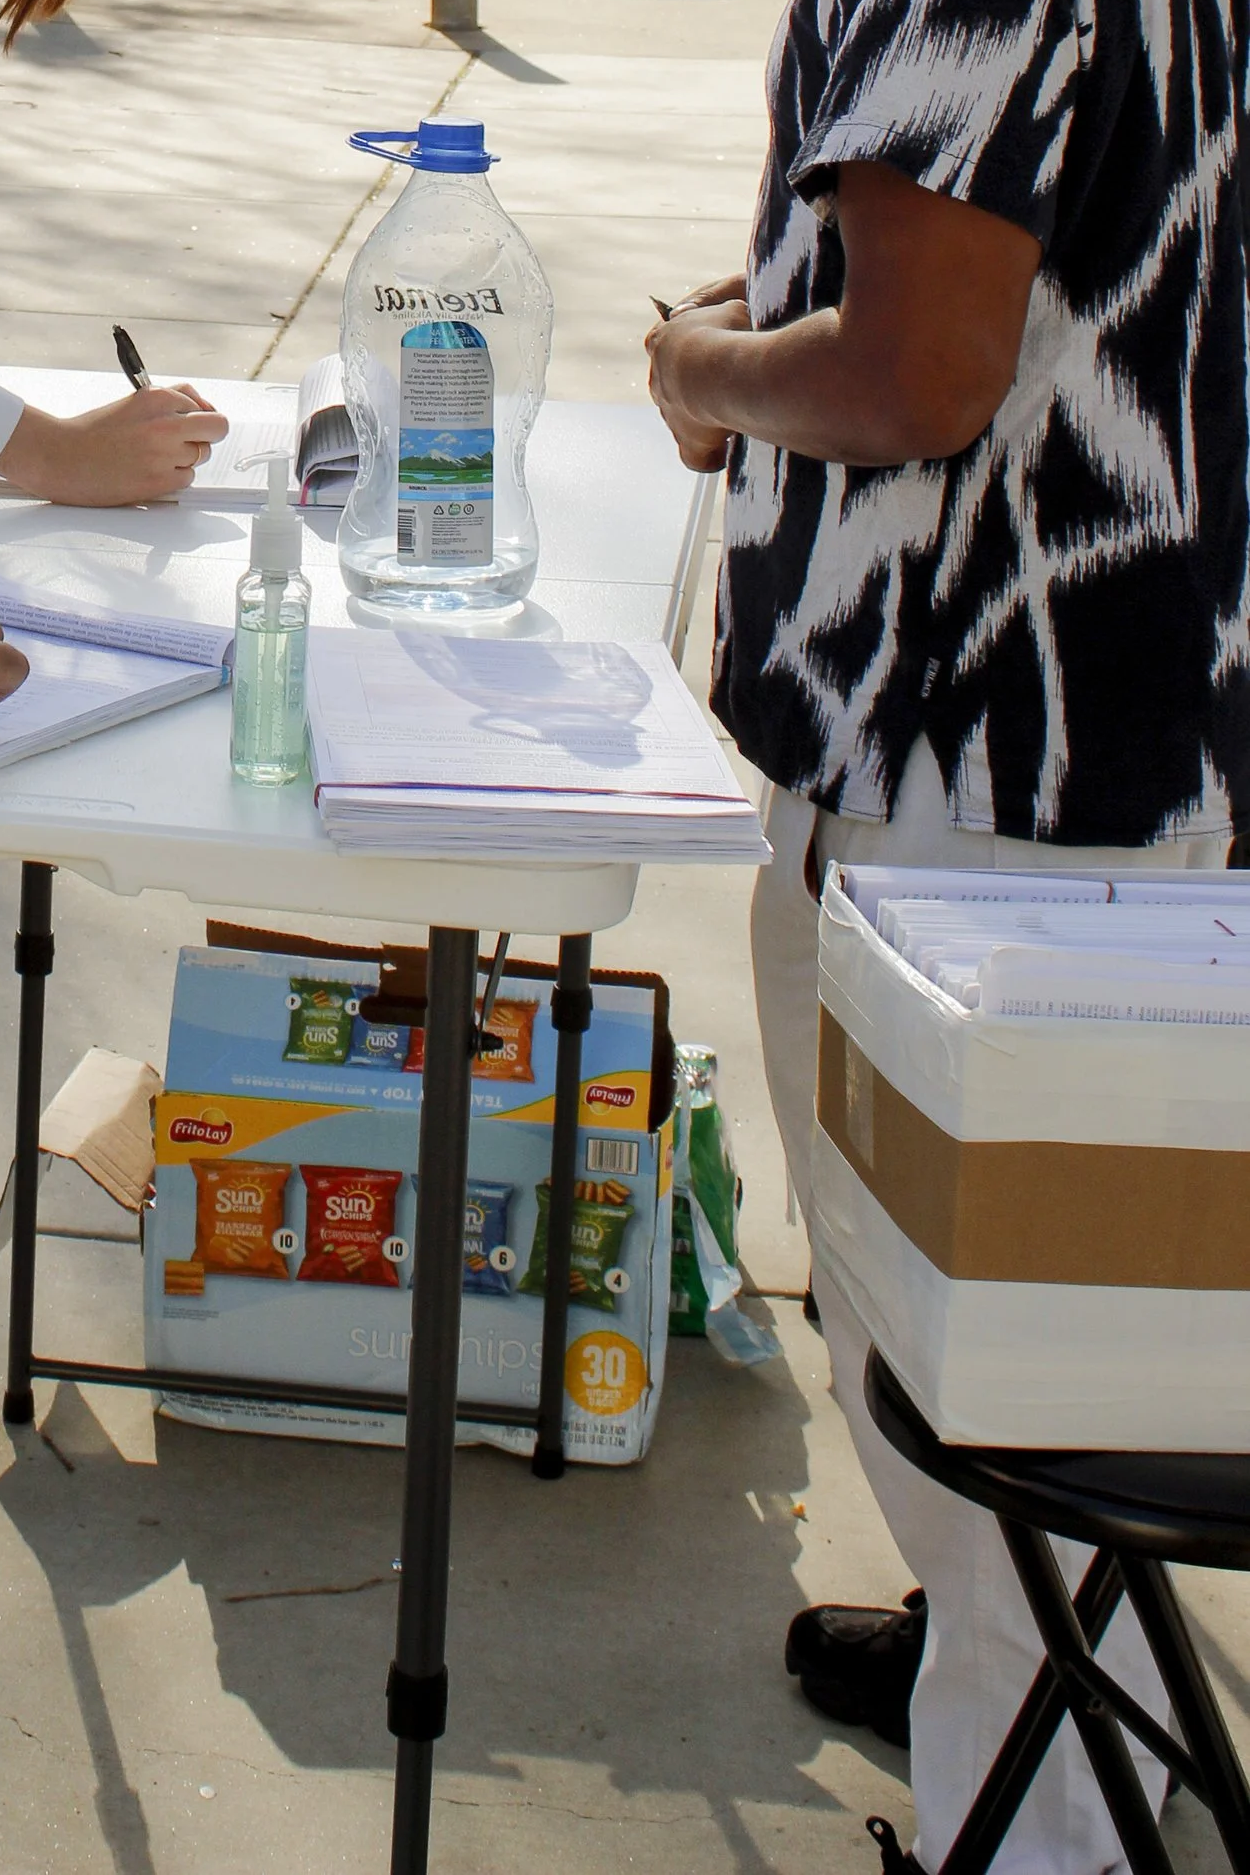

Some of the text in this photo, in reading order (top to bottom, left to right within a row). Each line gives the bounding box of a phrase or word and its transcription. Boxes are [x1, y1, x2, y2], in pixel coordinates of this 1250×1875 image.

[305, 1026, 339, 1045] Sun
[367, 1032, 398, 1052] Sun
[382, 1087, 412, 1101] TOP
[471, 1094, 502, 1108] TEA
[215, 1188, 263, 1214] Sun
[325, 1196, 373, 1221] Sun
[232, 1205, 262, 1214] CHIPS
[342, 1213, 372, 1221] CHIPS
[571, 1225, 601, 1241] un
[279, 1234, 293, 1248] 10
[390, 1242, 403, 1257] 10
[499, 1251, 507, 1265] 6
[613, 1273, 621, 1288] 4
[580, 1344, 626, 1387] 30
